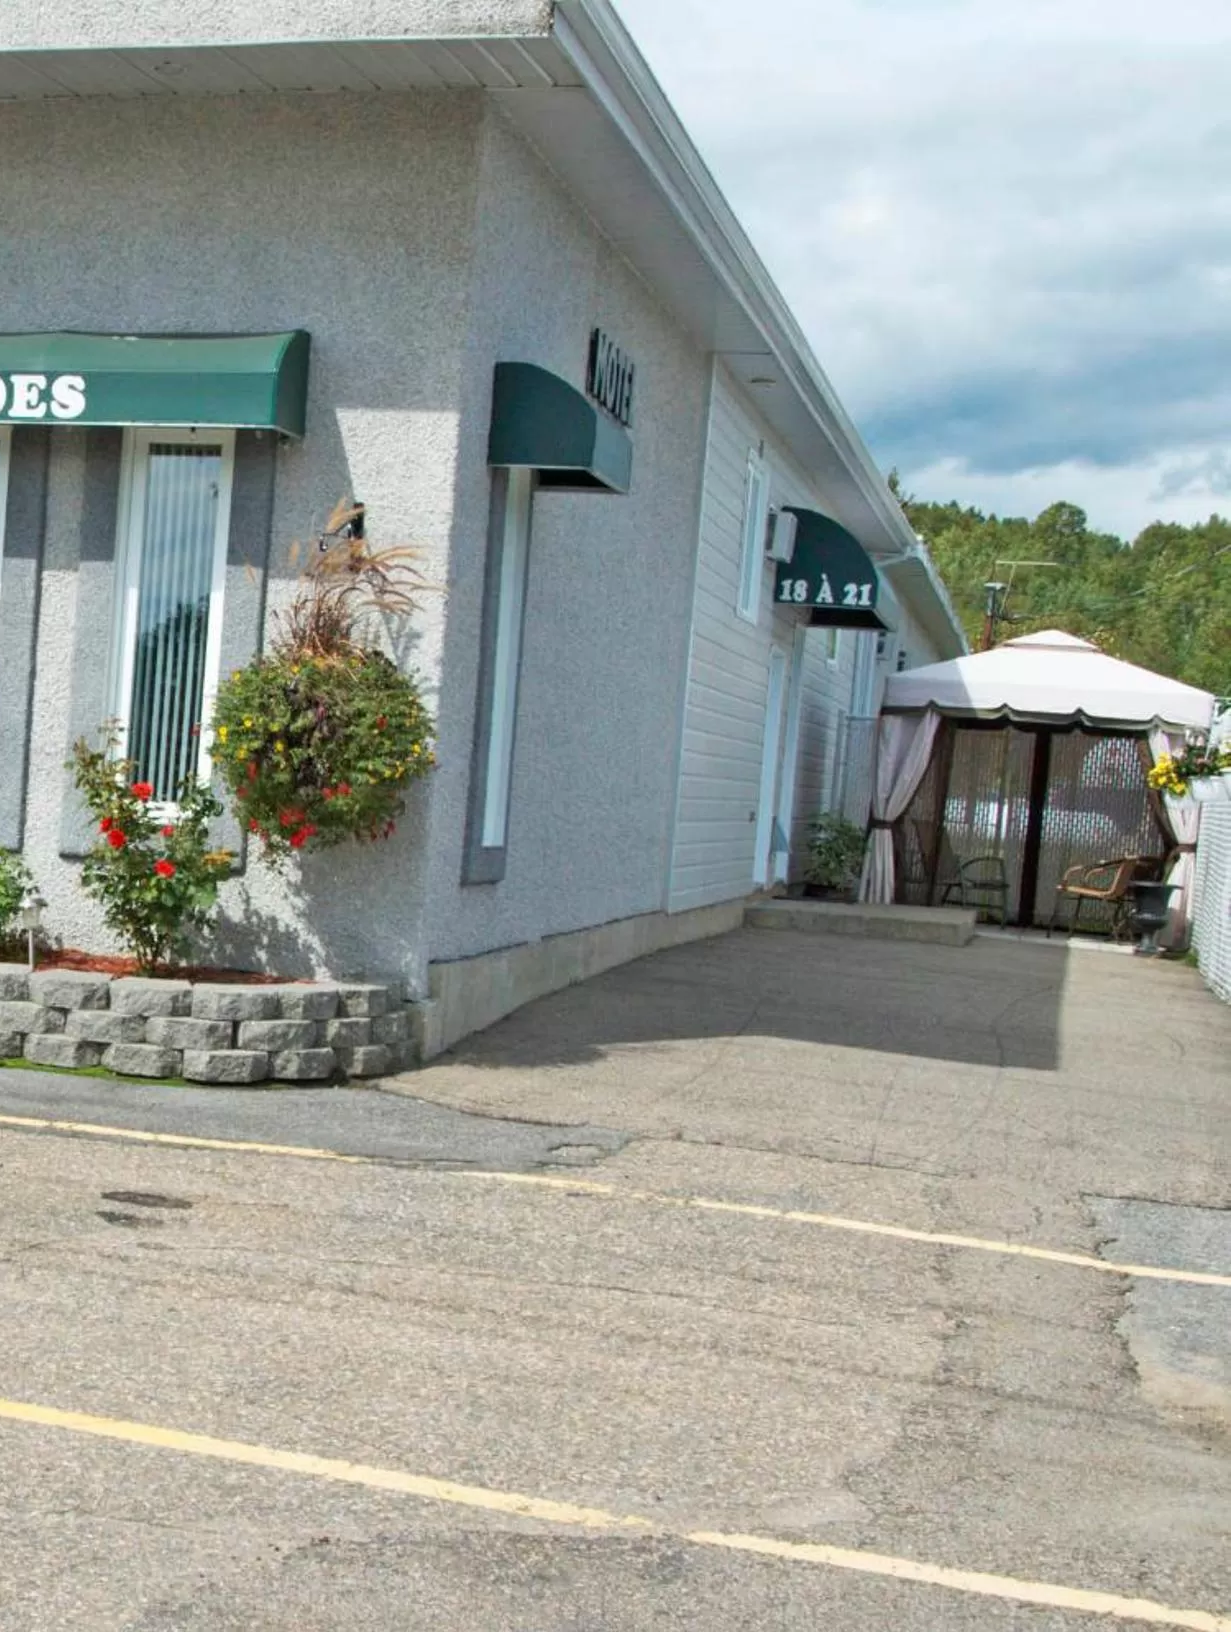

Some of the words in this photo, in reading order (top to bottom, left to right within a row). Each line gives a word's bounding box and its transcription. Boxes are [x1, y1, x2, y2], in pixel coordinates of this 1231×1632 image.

[779, 579, 808, 602] 18
[815, 573, 834, 603] À
[842, 583, 872, 606] 21
